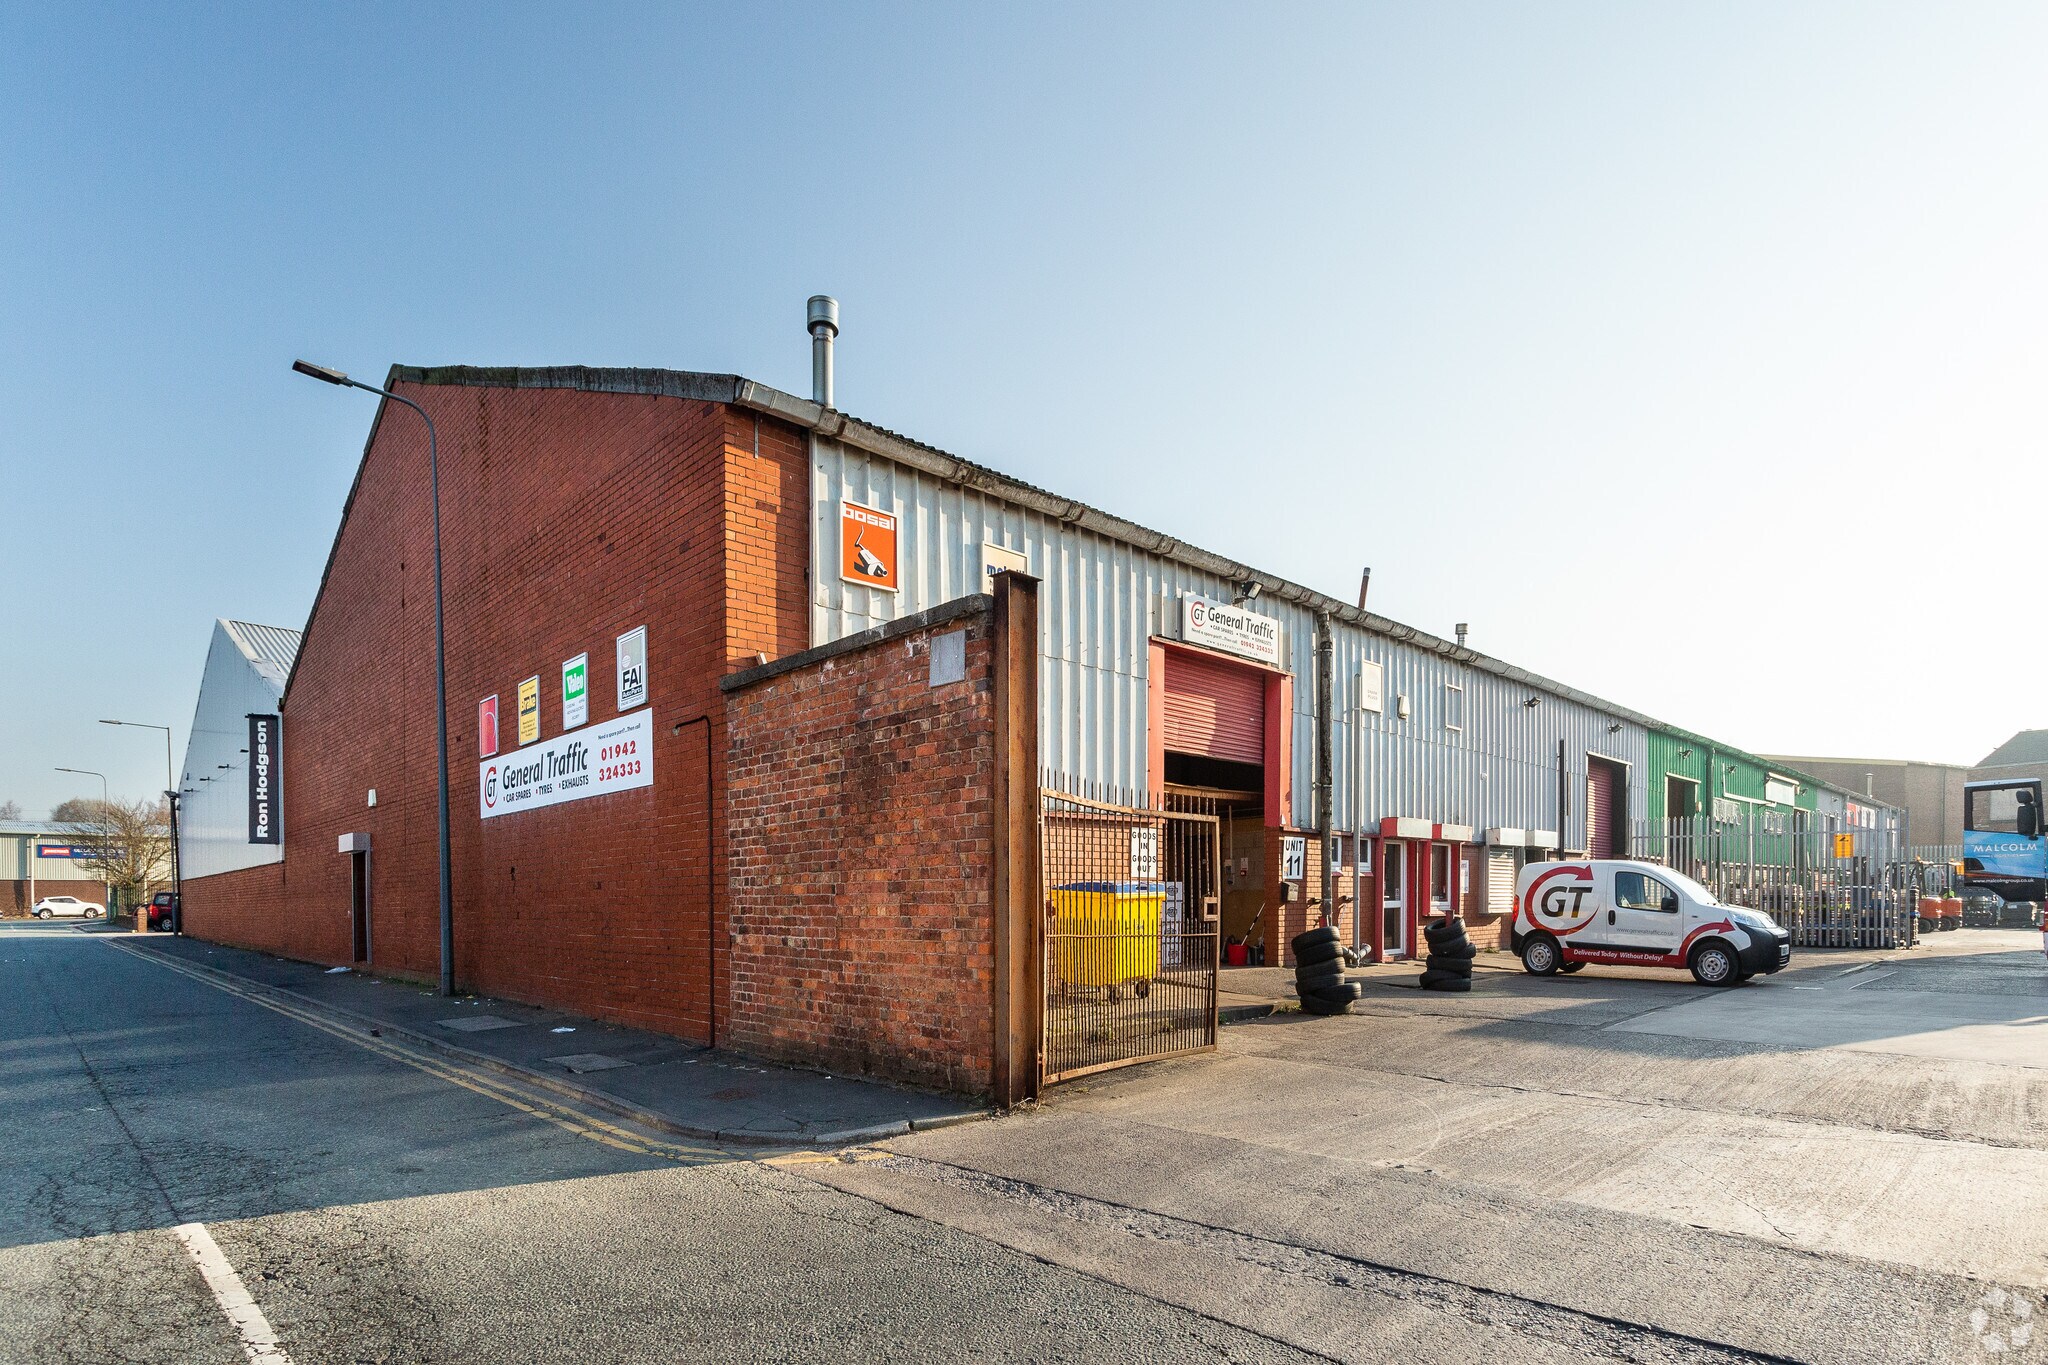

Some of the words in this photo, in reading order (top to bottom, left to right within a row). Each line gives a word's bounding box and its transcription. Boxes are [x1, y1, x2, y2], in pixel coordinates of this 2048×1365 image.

[843, 504, 895, 531] bosal
[1194, 608, 1205, 621] GT
[1208, 607, 1244, 630] General
[1246, 618, 1274, 640] Traffic
[1240, 640, 1254, 649] 01942
[567, 673, 584, 694] Valeo
[623, 665, 642, 690] FAI
[256, 721, 270, 800] Hodgson
[601, 740, 636, 761] 01942
[503, 753, 544, 790] General
[547, 741, 588, 779] Traffic
[599, 760, 641, 781] 324333
[487, 778, 497, 798] GT
[506, 793, 515, 803] CAR
[515, 788, 532, 801] SPARES
[539, 783, 553, 795] TYRES
[562, 774, 589, 790] EXHAUSTS
[257, 802, 269, 838] Ron
[1141, 842, 1149, 850] IN
[1285, 840, 1303, 851] UNIT
[1974, 844, 2037, 853] MALCOLM
[1286, 855, 1300, 876] 11
[1541, 886, 1593, 918] GT
[1573, 949, 1600, 957] Delivered
[1600, 950, 1617, 959] Today
[1619, 952, 1644, 960] Without
[1644, 953, 1664, 962] Delay!
